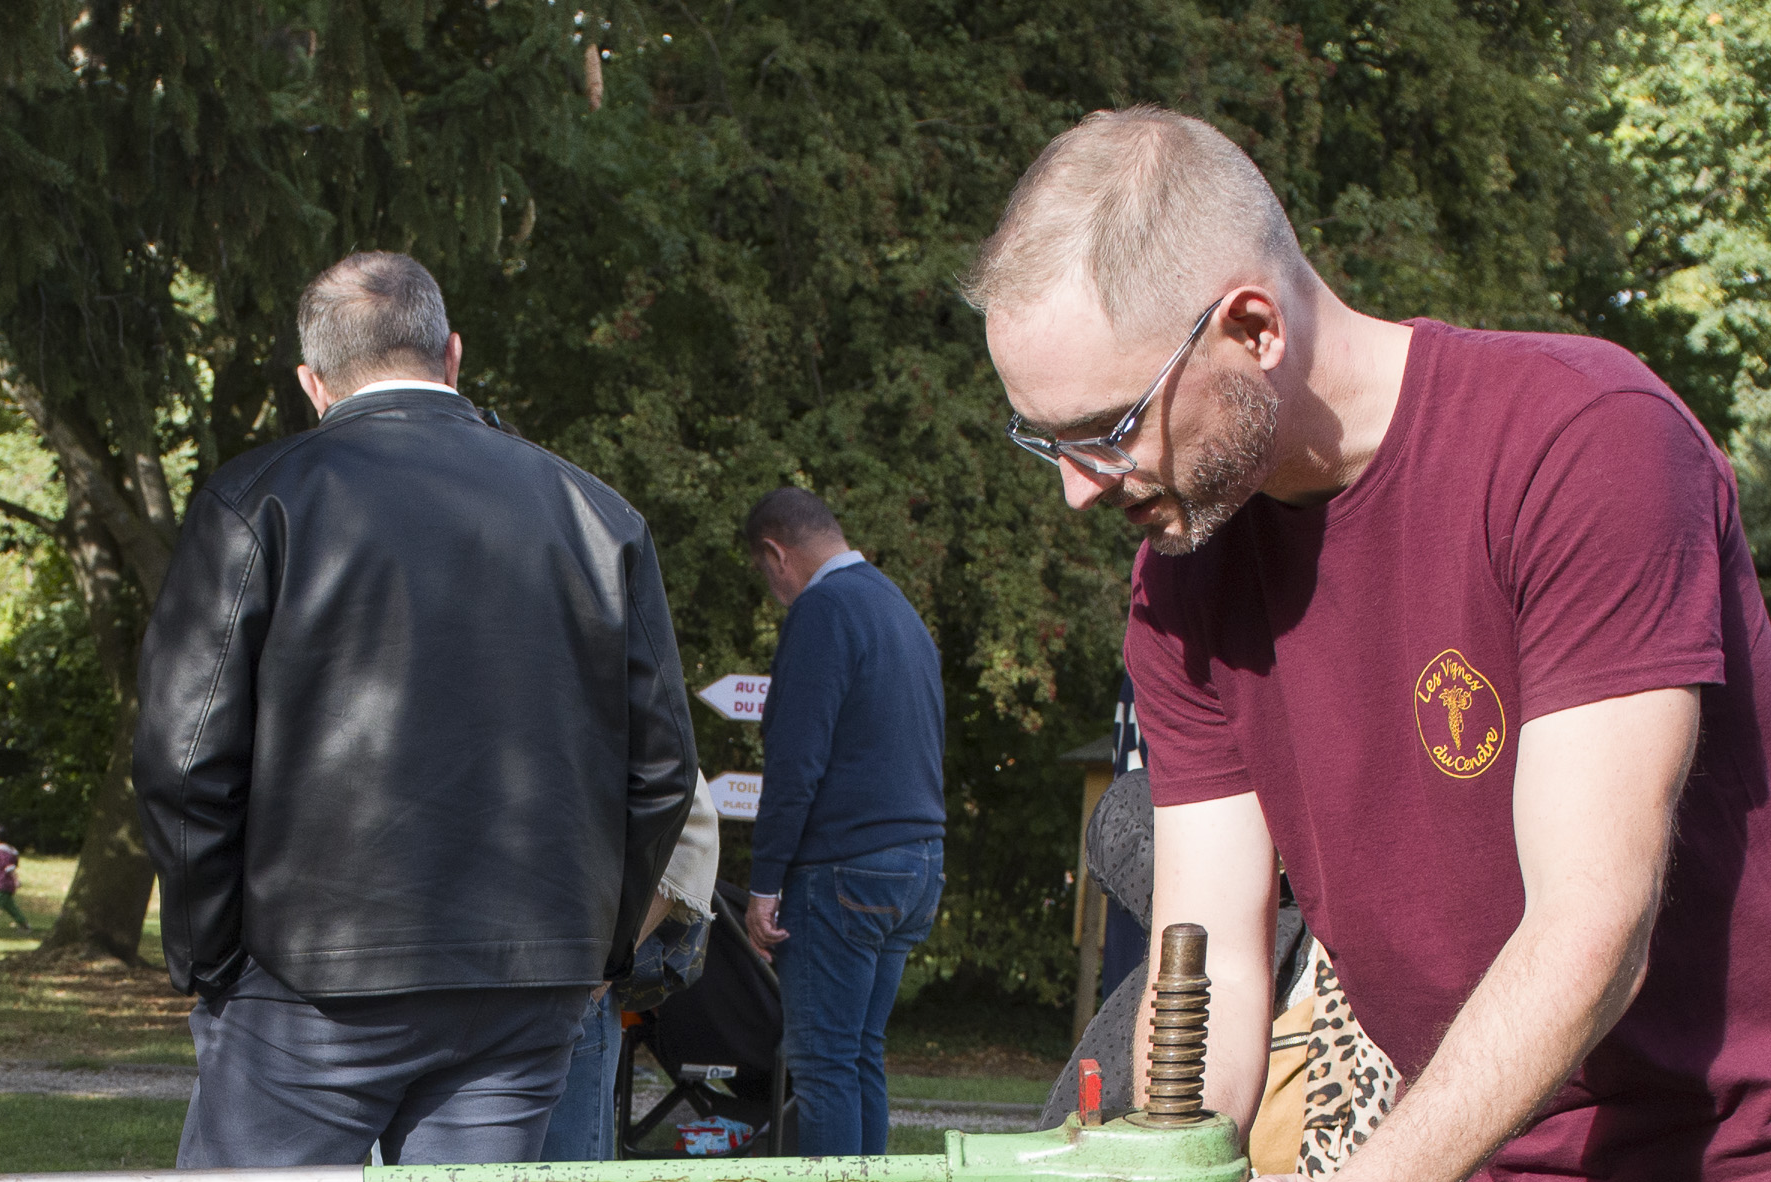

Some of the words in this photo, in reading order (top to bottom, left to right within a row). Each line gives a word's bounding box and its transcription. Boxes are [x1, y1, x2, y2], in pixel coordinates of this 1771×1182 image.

[1418, 671, 1442, 703] Les
[1440, 658, 1484, 691] Vignes
[735, 681, 755, 694] AU
[734, 701, 755, 713] DU
[1432, 744, 1455, 767] du
[1454, 727, 1499, 772] Cendre
[728, 781, 759, 794] TOIL
